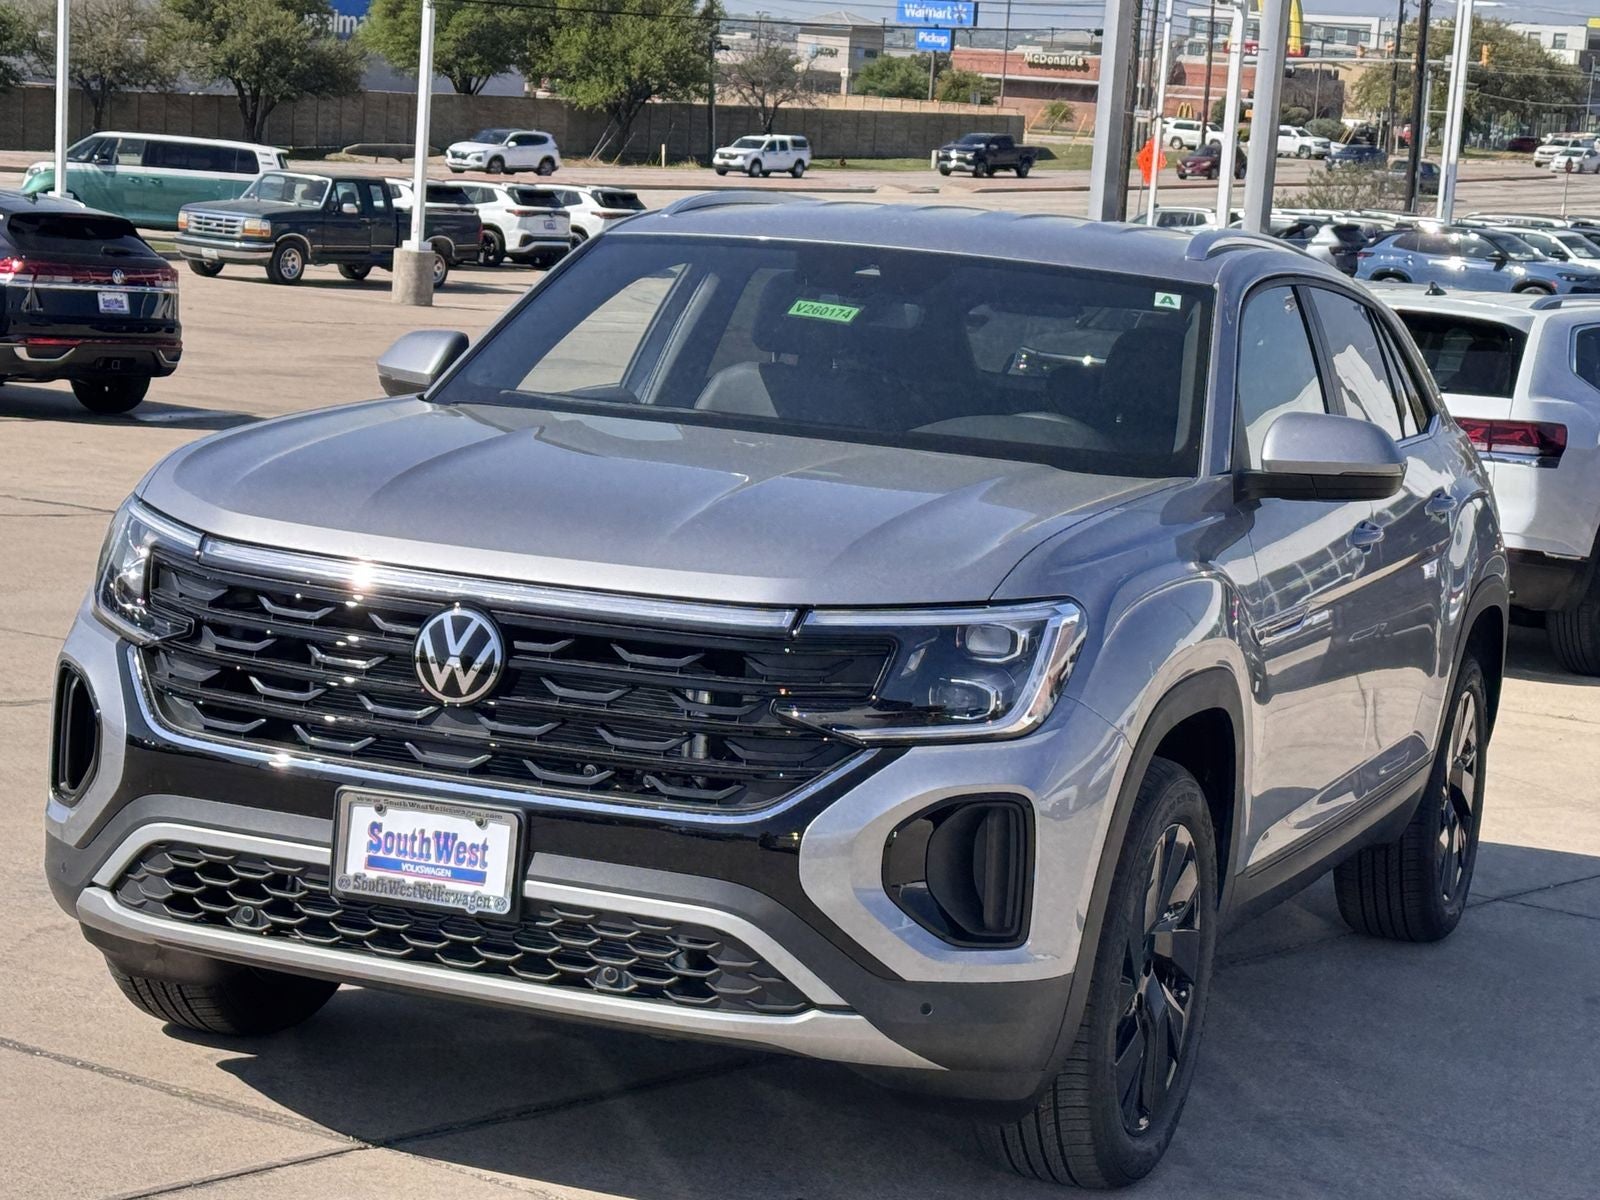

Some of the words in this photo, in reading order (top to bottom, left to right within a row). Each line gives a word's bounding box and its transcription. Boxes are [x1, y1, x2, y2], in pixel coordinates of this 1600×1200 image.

[904, 3, 953, 20] Walmart
[918, 31, 948, 46] Pickup
[1024, 52, 1084, 67] McDonald's
[1159, 295, 1175, 306] A
[796, 303, 852, 319] V260174
[366, 820, 489, 870] SouthWest
[401, 862, 452, 877] VOLKSWAGEN
[353, 873, 492, 910] SouthWestVolkswagen
